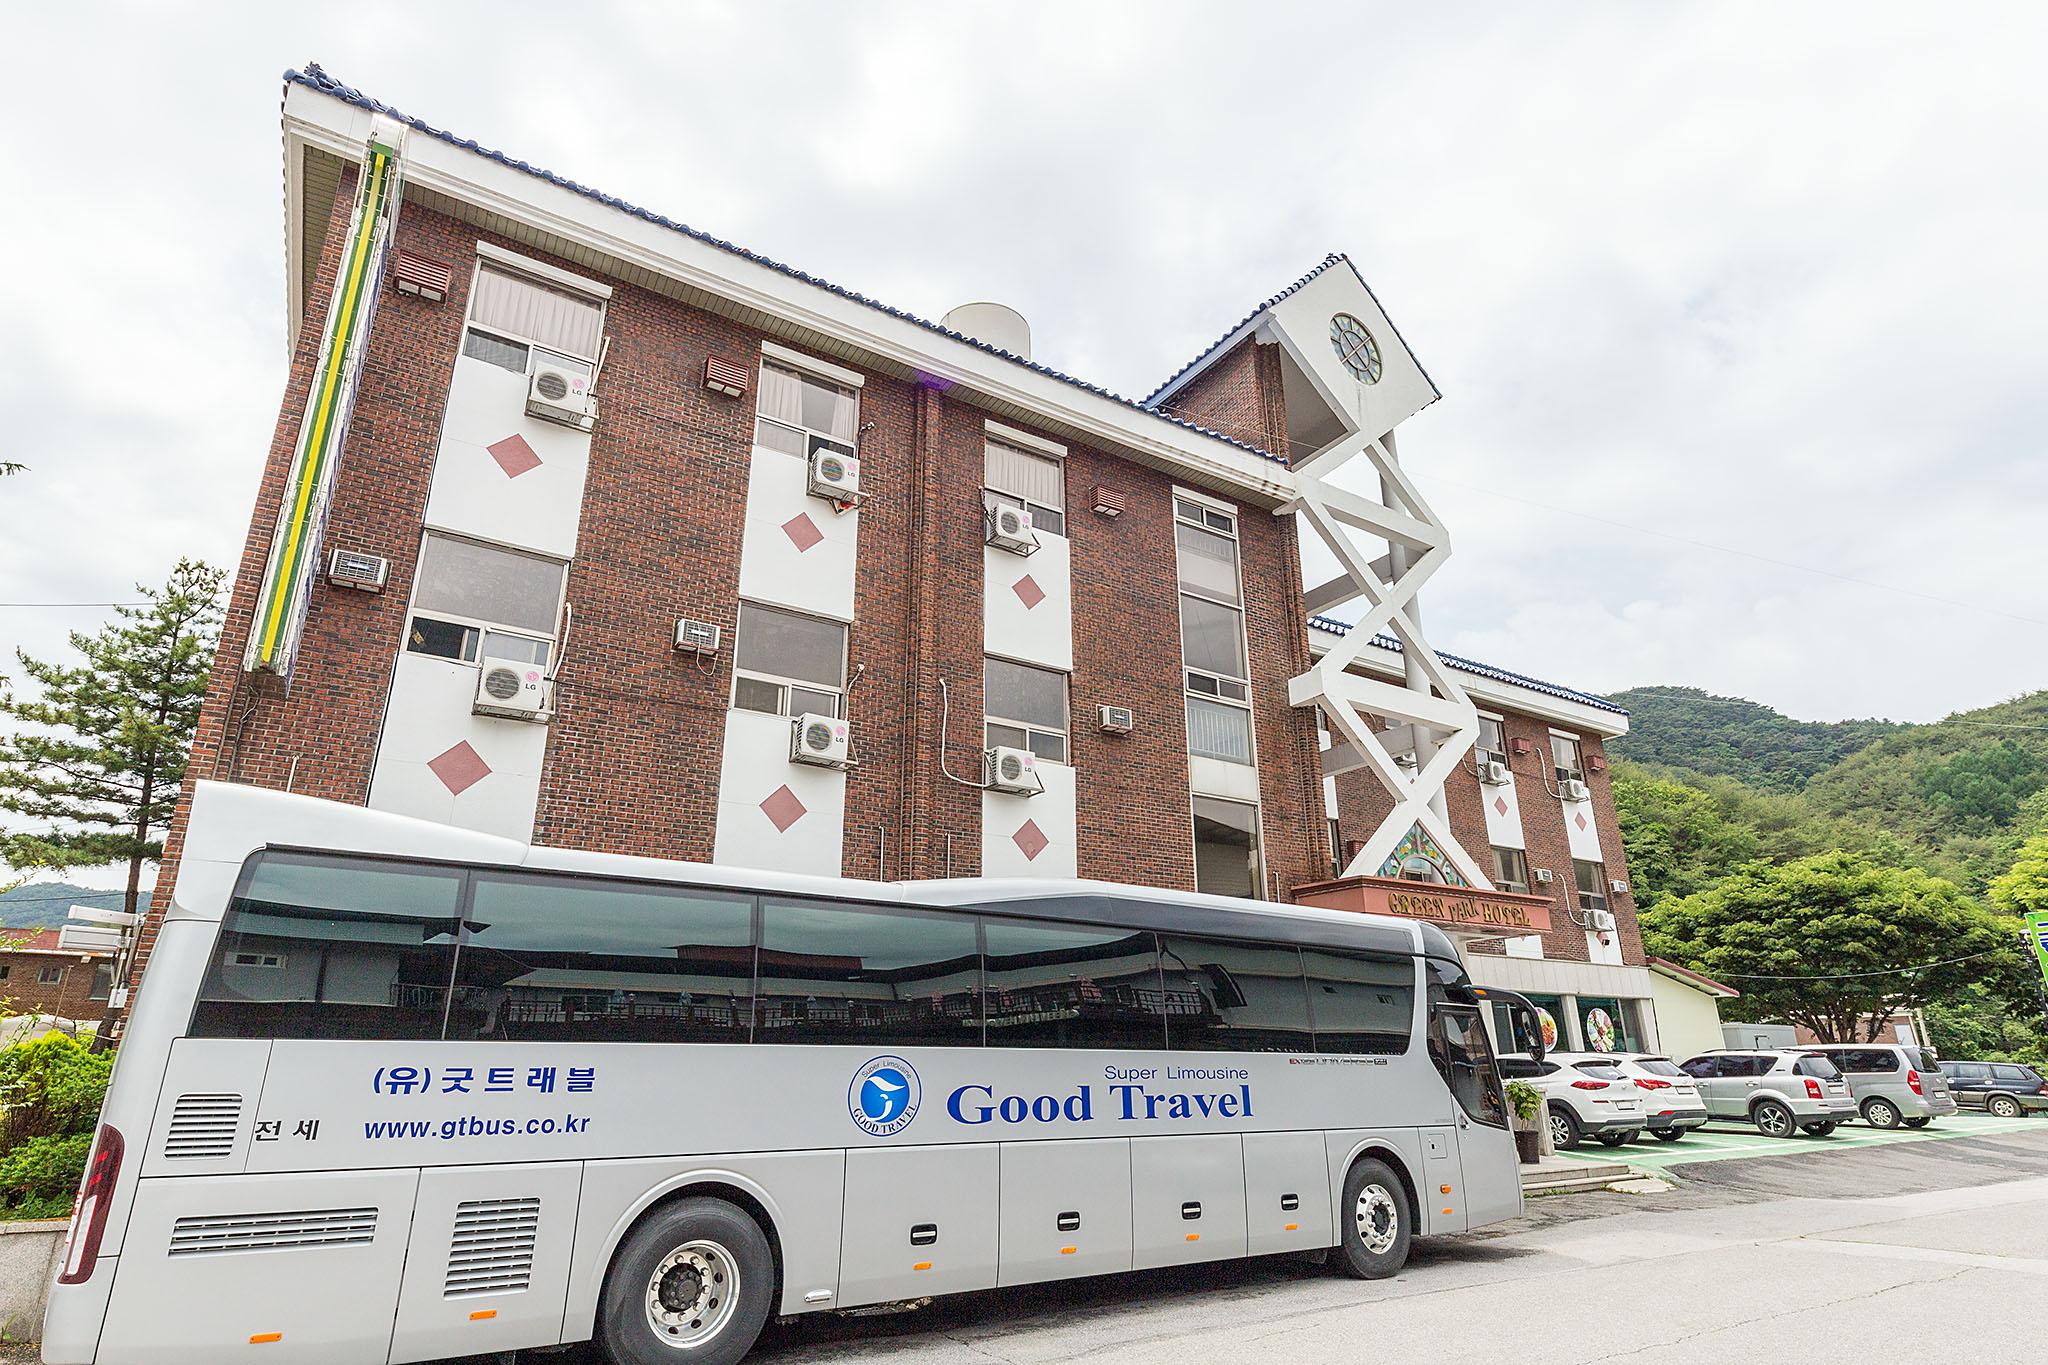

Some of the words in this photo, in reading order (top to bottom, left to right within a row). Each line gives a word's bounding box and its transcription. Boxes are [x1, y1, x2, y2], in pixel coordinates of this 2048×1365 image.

[525, 683, 537, 691] LG
[1388, 892, 1445, 918] GREEN
[1448, 897, 1480, 922] PARK
[1481, 902, 1532, 927] HOTEL
[861, 1062, 880, 1078] Super
[1104, 1065, 1157, 1082] Super
[1166, 1065, 1249, 1080] Limousine
[946, 1084, 1095, 1125] Good
[1108, 1083, 1254, 1121] Travel
[364, 1113, 591, 1140] www.gtbus.co.kr
[853, 1107, 879, 1133] GOOD
[880, 1104, 917, 1134] TRAVEL
